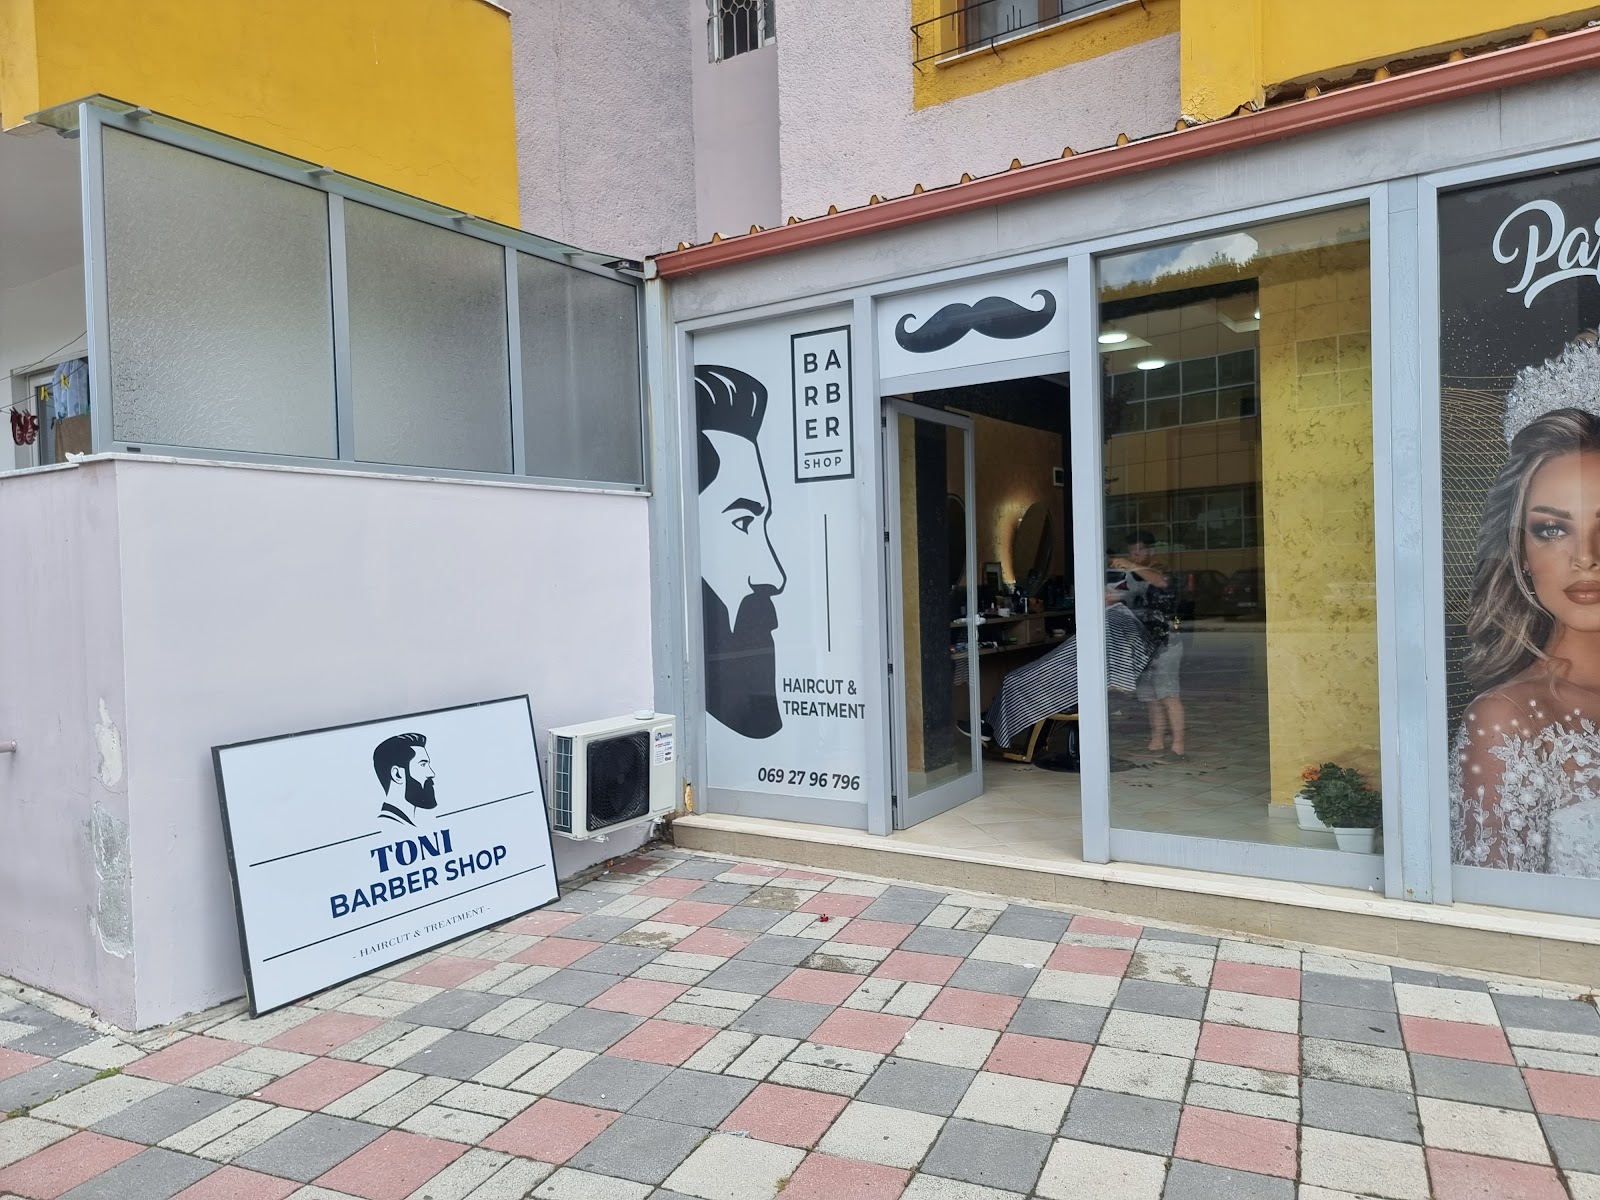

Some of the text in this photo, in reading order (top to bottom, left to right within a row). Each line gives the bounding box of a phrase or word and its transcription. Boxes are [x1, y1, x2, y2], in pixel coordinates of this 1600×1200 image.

[1493, 199, 1600, 308] Pa
[804, 456, 842, 469] SHOP
[783, 678, 857, 695] HAIRCUT &
[783, 700, 865, 719] TREATMENT
[758, 767, 860, 790] 069 27 96 796
[370, 828, 453, 873] TONI
[330, 845, 507, 919] BARBER SHOP
[359, 932, 411, 958] HAIRCUT
[413, 929, 422, 938] &
[423, 905, 485, 935] TREATMENT
